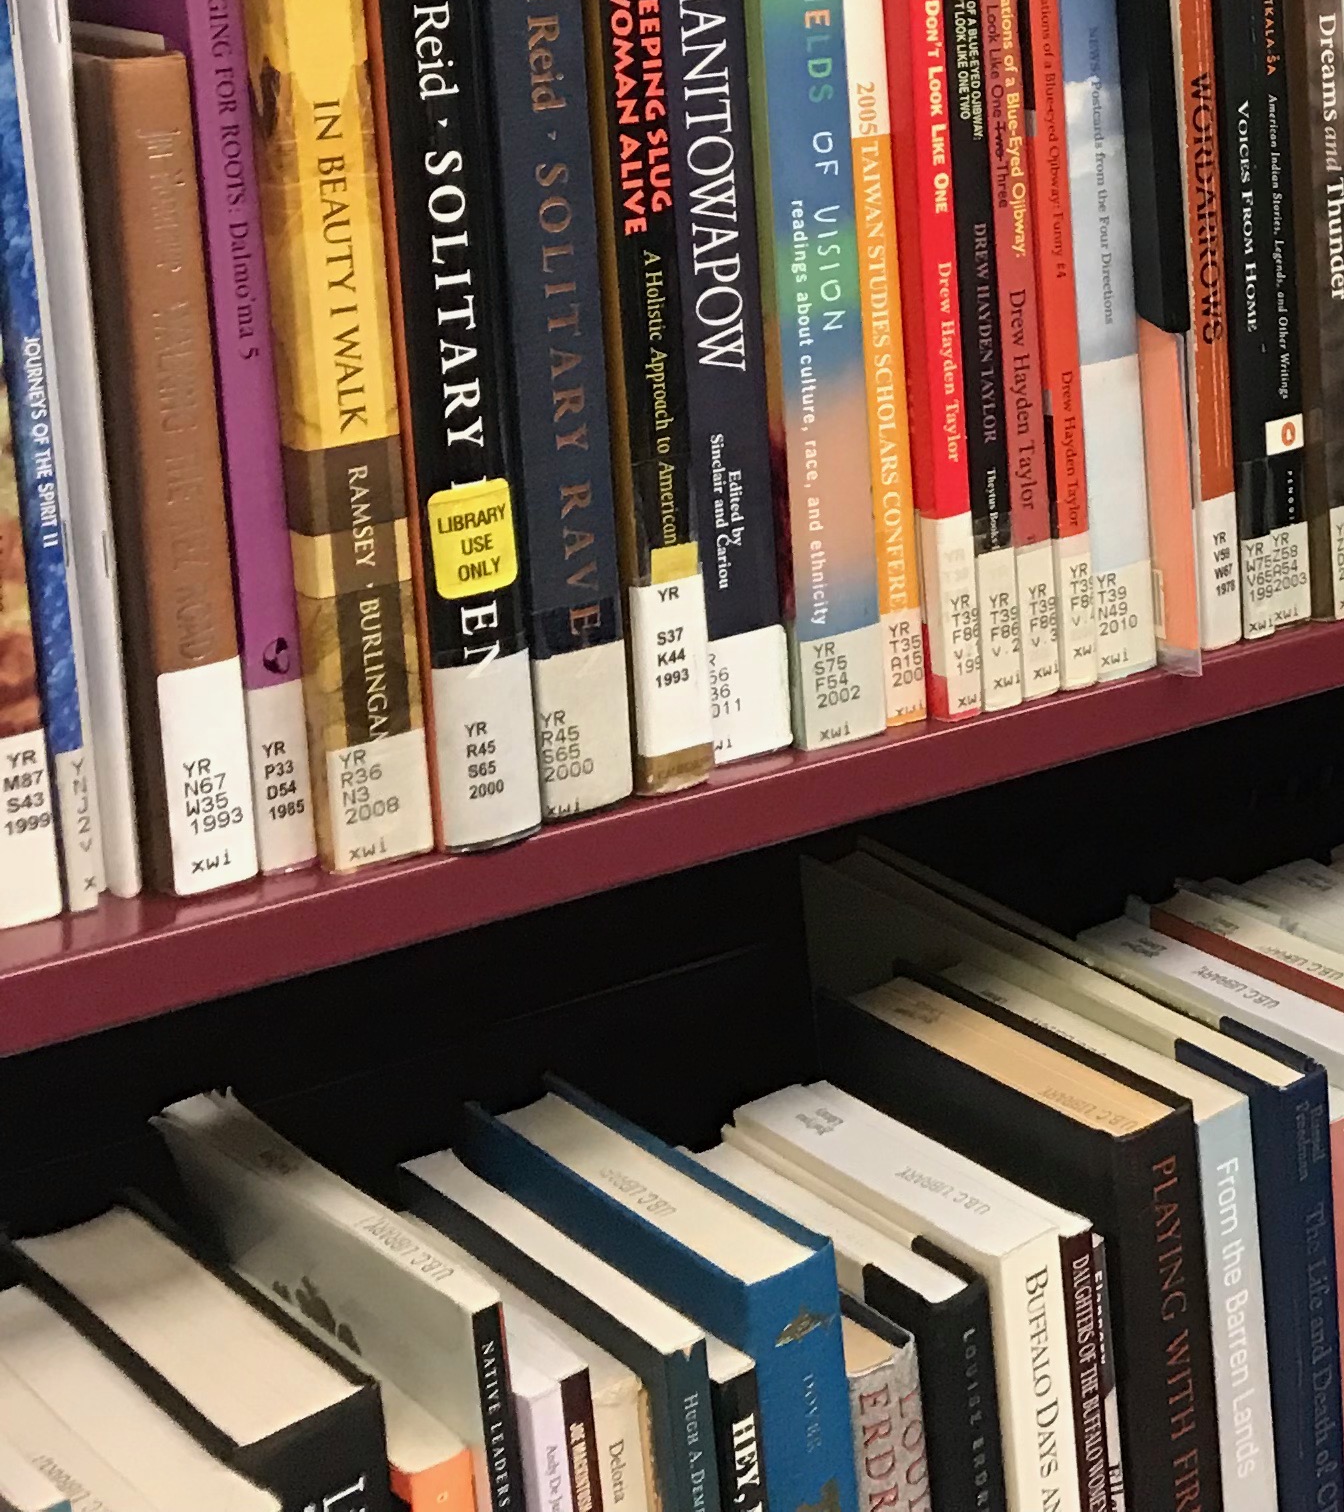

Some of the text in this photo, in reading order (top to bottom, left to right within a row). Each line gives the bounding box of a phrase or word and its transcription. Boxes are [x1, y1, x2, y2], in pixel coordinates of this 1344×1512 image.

[414, 4, 459, 100] Reid
[1319, 14, 1336, 121] Dreams
[313, 98, 342, 140] IN
[1326, 127, 1342, 171] and
[619, 134, 648, 236] ALIVE
[647, 130, 672, 213] SLUG
[812, 131, 839, 176] OF
[318, 152, 356, 293] BEAUTY
[424, 149, 485, 447] SOLITARY
[814, 204, 846, 333] VISION
[23, 337, 46, 418] JOURNEYS
[332, 325, 368, 434] WALK
[33, 422, 48, 442] OF
[791, 199, 828, 625] readings about culture, race, and ethnicity
[35, 446, 51, 477] THE
[38, 481, 56, 532] SPIRIT
[348, 465, 375, 567] RAMSEY
[437, 504, 506, 534] LIBRARY
[457, 557, 501, 584] ONLY
[461, 537, 494, 556] USE
[657, 587, 679, 603] YR
[657, 628, 684, 646] S37
[657, 648, 686, 667] K44
[655, 667, 690, 689] 1993
[1217, 1157, 1259, 1479] From the Barren Lands
[481, 1341, 511, 1508] NATIVE LEADERS
